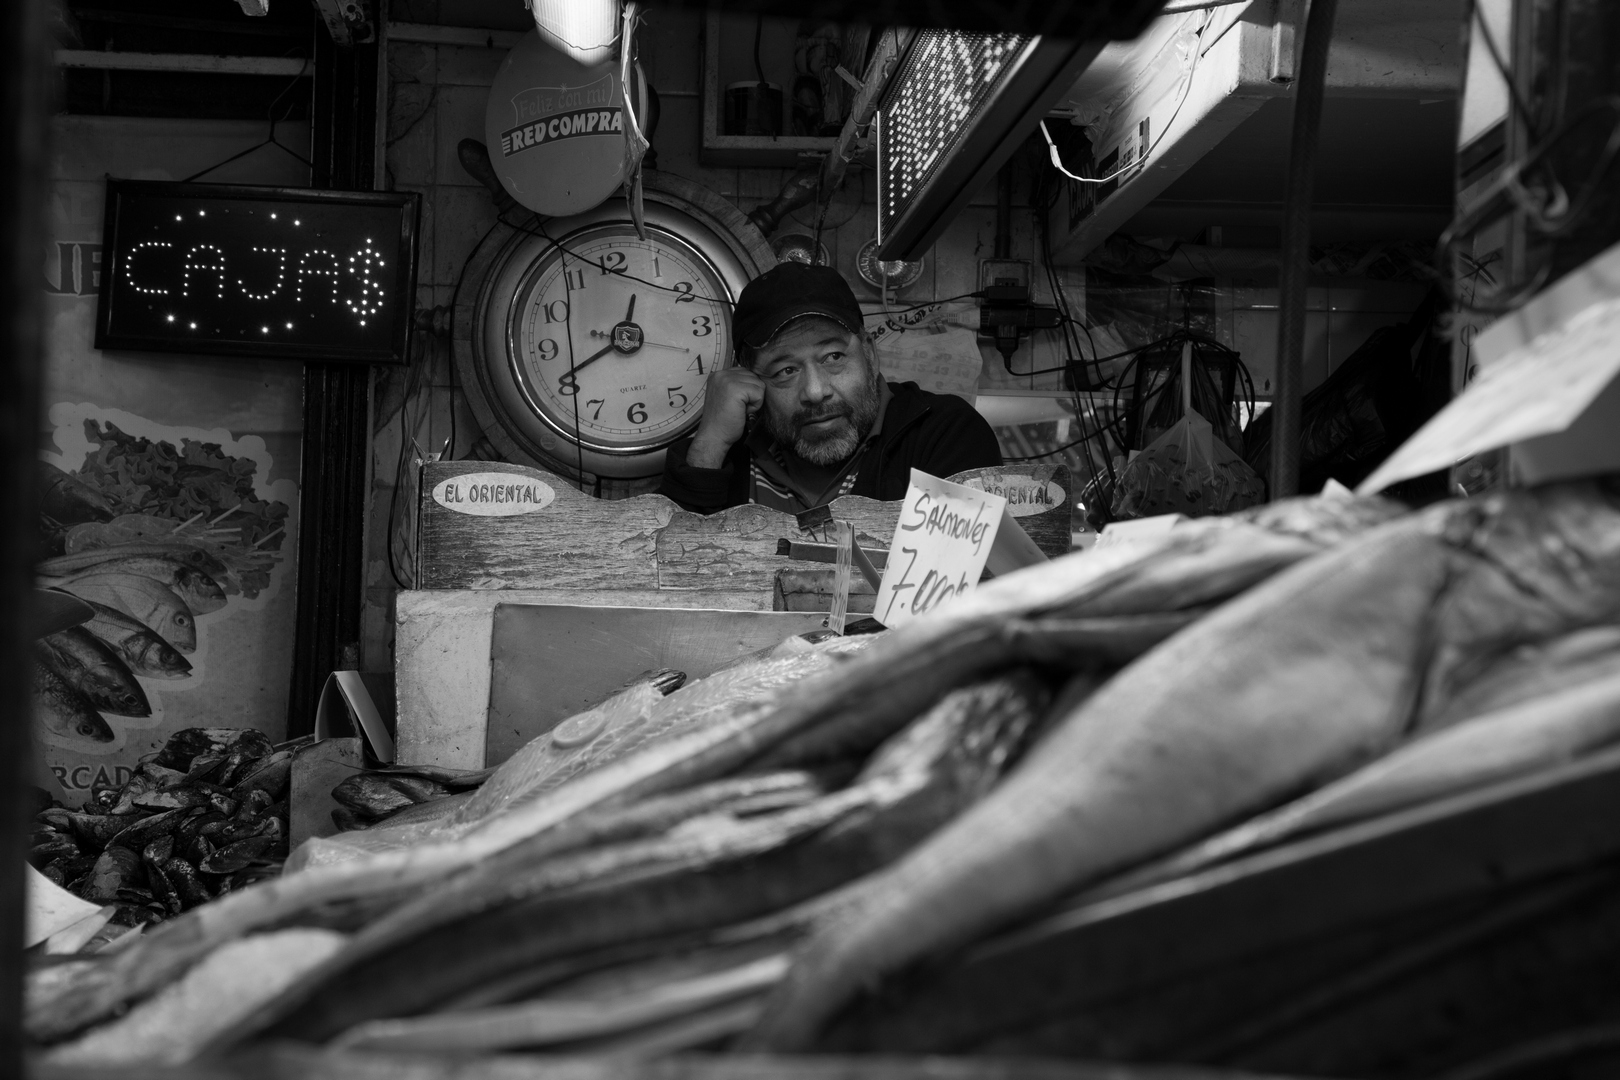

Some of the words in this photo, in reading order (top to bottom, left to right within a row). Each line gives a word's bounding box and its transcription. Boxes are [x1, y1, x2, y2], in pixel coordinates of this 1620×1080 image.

[519, 94, 553, 119] Feliz
[558, 91, 582, 109] con
[587, 83, 606, 105] mi
[597, 251, 629, 276] 12
[652, 256, 663, 279] 1
[565, 268, 587, 291] 11
[672, 281, 696, 304] 2
[541, 300, 570, 324] 10
[691, 315, 712, 337] 3
[537, 338, 559, 361] 9
[686, 354, 708, 377] 4
[557, 372, 581, 397] 8
[619, 384, 648, 394] QUARTZ
[667, 385, 688, 409] 5
[585, 398, 605, 421] 7
[626, 402, 649, 425] 6
[444, 484, 463, 504] EL
[469, 483, 542, 504] ORIENTAL
